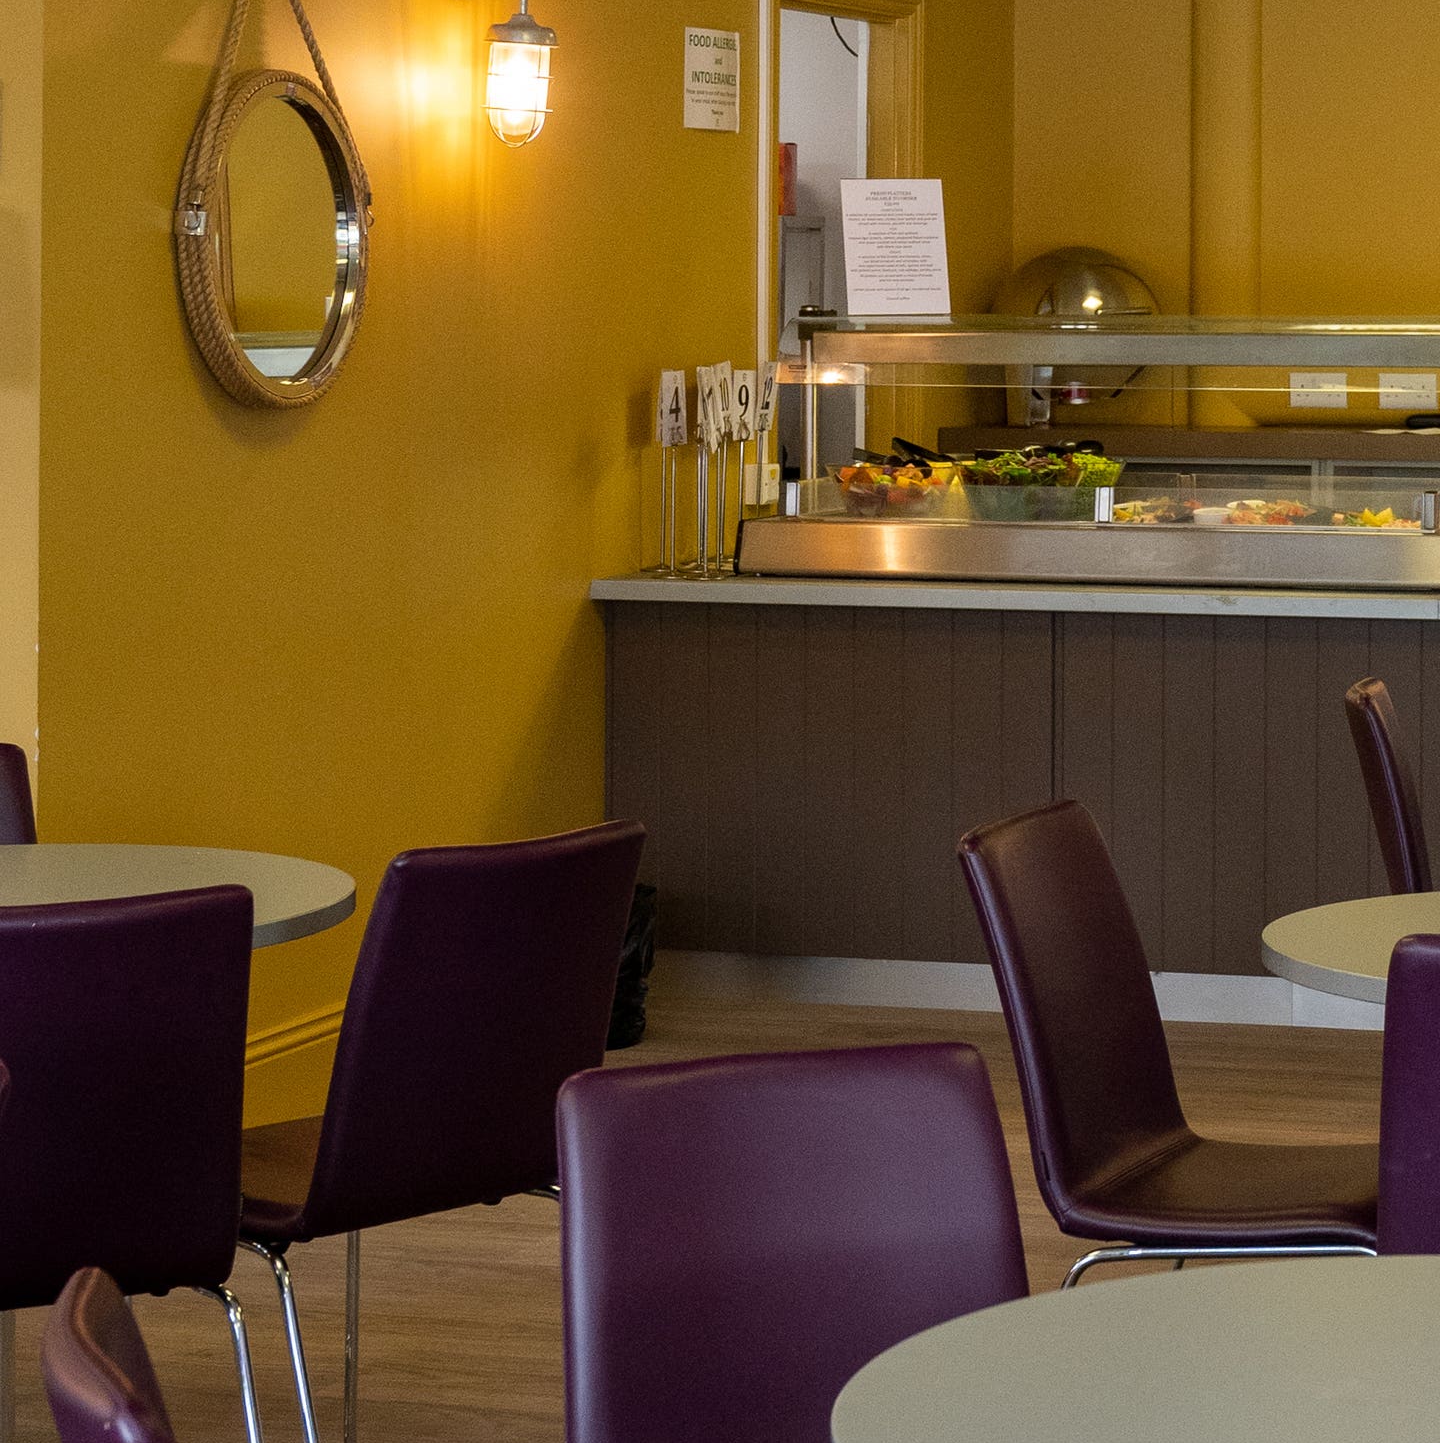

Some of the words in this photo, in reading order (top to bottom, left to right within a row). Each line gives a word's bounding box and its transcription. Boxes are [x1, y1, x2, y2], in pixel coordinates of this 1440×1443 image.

[688, 34, 711, 48] FOOD
[669, 386, 681, 423] 4
[719, 377, 730, 411] 10
[738, 384, 749, 418] 9
[761, 377, 773, 410] 12
